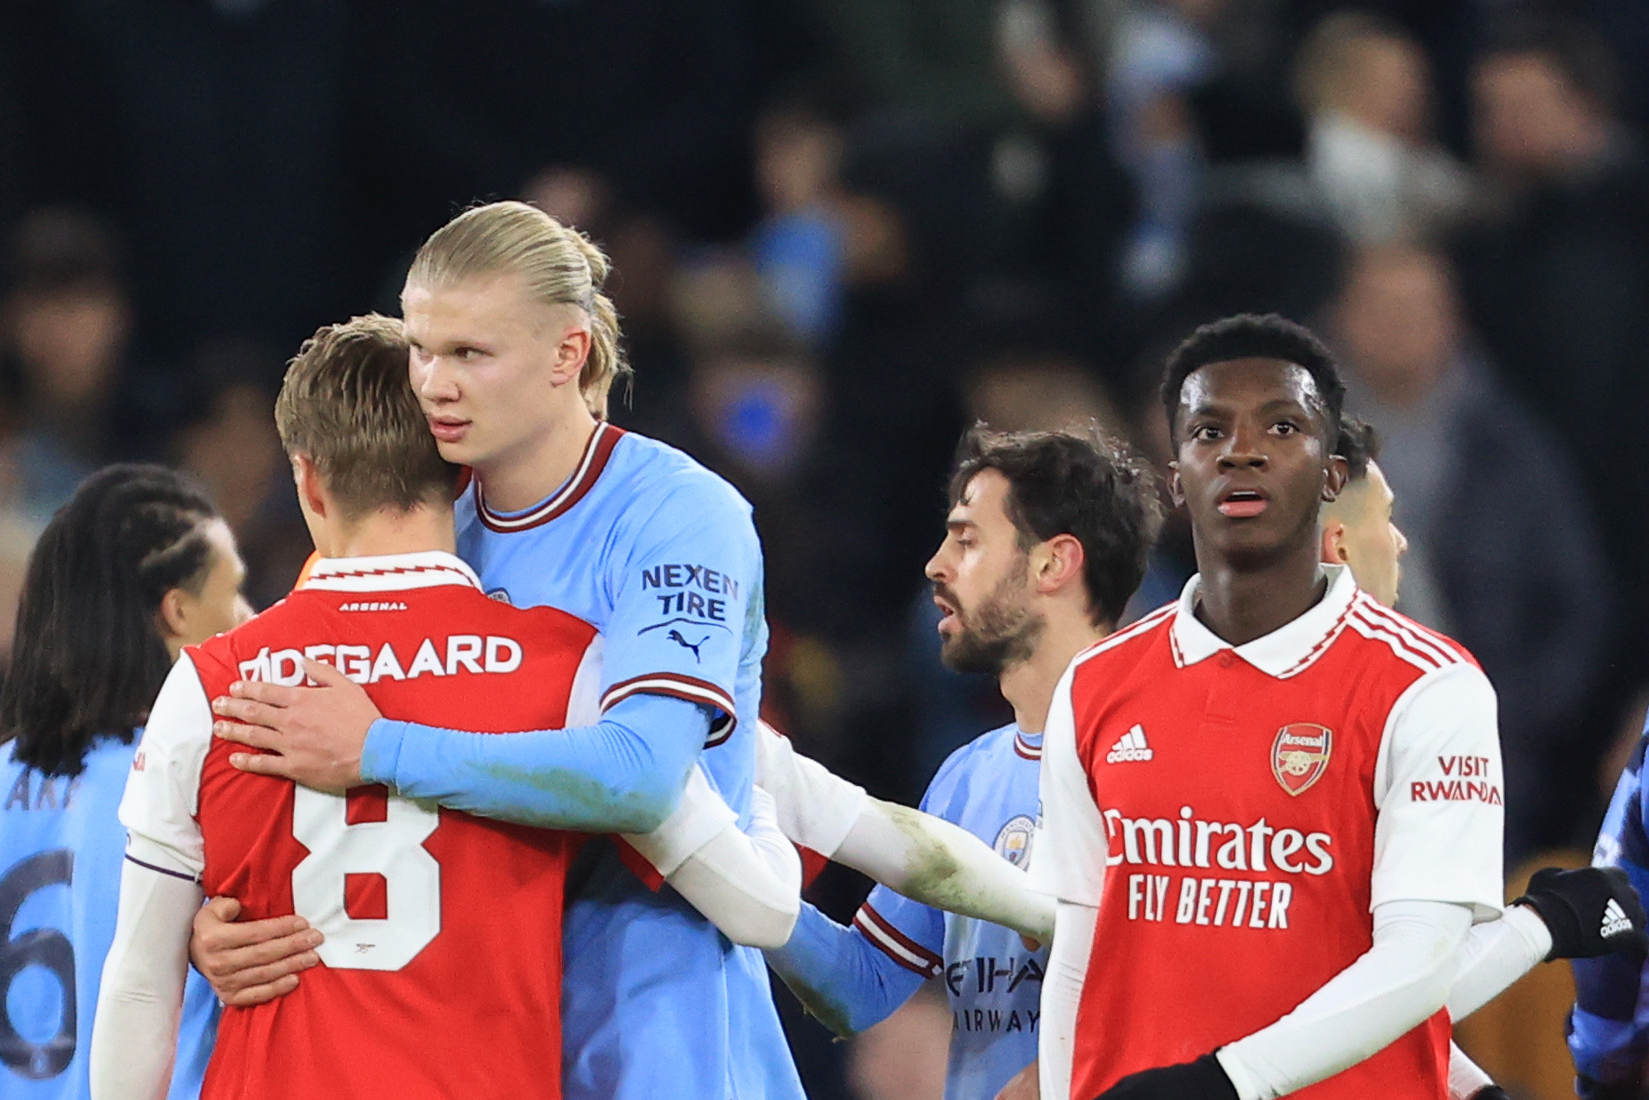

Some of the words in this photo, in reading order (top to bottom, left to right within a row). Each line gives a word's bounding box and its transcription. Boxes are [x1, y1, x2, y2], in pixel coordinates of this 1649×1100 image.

[641, 563, 739, 600] NEXEN
[339, 601, 408, 612] ARSENAL
[657, 592, 727, 622] TIRE
[1280, 733, 1324, 748] Arsenal
[1106, 747, 1153, 764] adidas
[1437, 755, 1490, 778] VISIT
[1411, 780, 1503, 806] RWANDA
[291, 783, 442, 972] 8
[1128, 874, 1170, 922] FLY
[1175, 876, 1293, 930] BETTER
[1599, 917, 1633, 939] adidas
